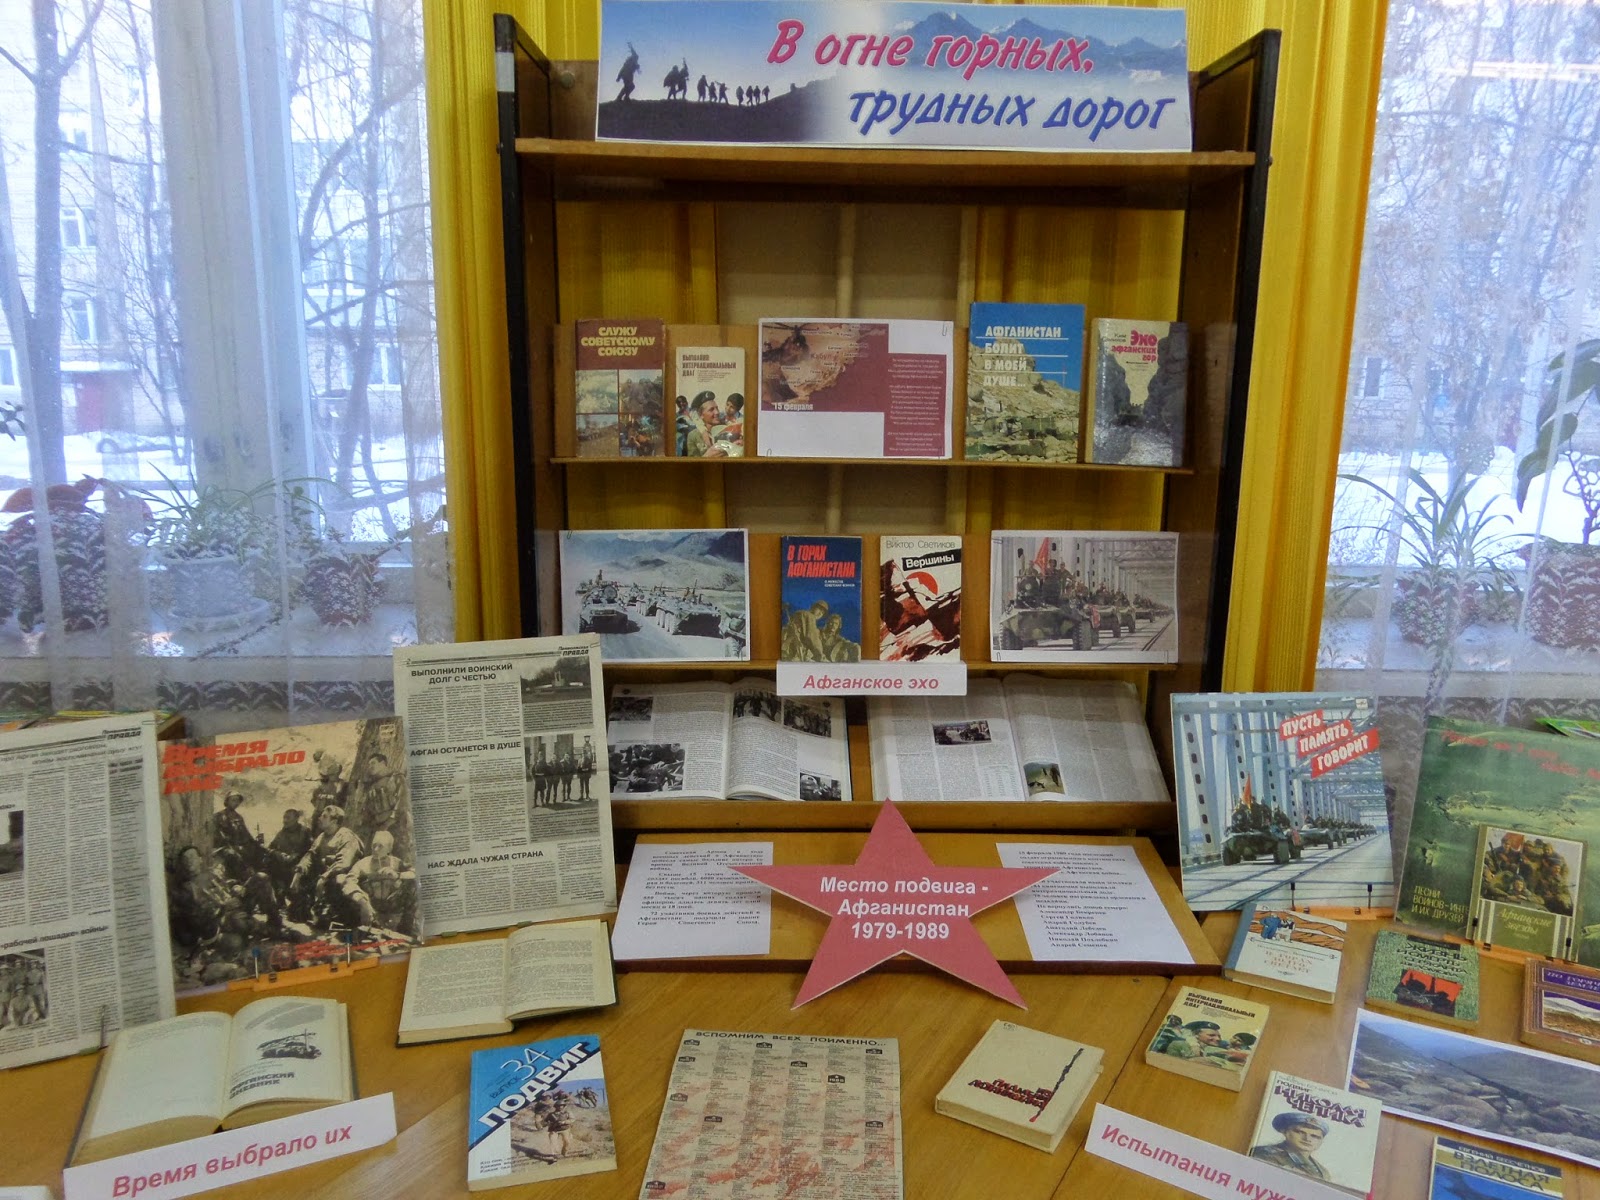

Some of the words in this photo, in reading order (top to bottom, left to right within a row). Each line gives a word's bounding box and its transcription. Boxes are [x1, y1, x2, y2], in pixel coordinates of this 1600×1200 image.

[767, 18, 805, 65] В
[814, 34, 913, 68] огне
[924, 33, 1095, 82] горных,
[847, 87, 1036, 136] трудных
[1042, 95, 1176, 143] дорог
[598, 326, 637, 336] СЛУЖУ
[985, 325, 1062, 338] АФГАНИСТАН
[1130, 329, 1158, 346] Эхо
[581, 336, 655, 347] СОВЕТСКОМУ
[984, 343, 1025, 354] БОЛИТ
[1111, 345, 1157, 354] афганских
[598, 347, 638, 357] СОЮЗУ
[1142, 354, 1157, 363] гор
[984, 360, 993, 370] В
[994, 358, 1027, 371] МОЕЙ
[773, 402, 783, 411] 15
[784, 403, 814, 412] февраля
[885, 539, 915, 549] Виктор
[917, 540, 956, 549] Светиков
[787, 545, 796, 561] В
[797, 545, 827, 561] ГОРАХ
[905, 553, 955, 569] Вершины
[787, 561, 857, 578] АФГАНИСТАНА
[411, 666, 467, 677] ВЫПОЛНИЛИ
[467, 662, 513, 673] ВОИНСКИЙ
[428, 676, 453, 685] ДОЛГ
[455, 675, 461, 683] С
[462, 672, 497, 682] ЧЕСТЬЮ
[803, 674, 903, 690] Афганское
[908, 678, 939, 690] эхо
[1281, 713, 1321, 737] ПУСТЬ
[1299, 723, 1350, 753] ПАМЯТЬ
[410, 747, 439, 757] АФГАН
[440, 743, 490, 754] ОСТАНЕТСЯ
[496, 741, 522, 751] ДУШЕ
[1316, 734, 1369, 771] ГОВОРИТ
[427, 860, 445, 869] НАС
[447, 856, 479, 868] ЖДАЛА
[480, 853, 510, 863] ЧУЖАЯ
[511, 850, 544, 861] СТРАНА
[819, 876, 889, 894] Место
[893, 876, 977, 896] подвига
[1413, 885, 1441, 898] ПЕСНИ
[836, 898, 970, 919] Афганистан
[1411, 904, 1418, 912] И
[1418, 905, 1430, 915] ИХ
[1431, 908, 1464, 923] ДРУЗЕЙ
[850, 921, 951, 940] 1979-1989
[695, 1031, 765, 1040] ВСПОМНИМ
[772, 1034, 802, 1042] ВСЕХ
[809, 1036, 887, 1046] ПОИМЕННО...
[500, 1048, 552, 1081] 34
[478, 1042, 590, 1128] ПОДВИГ
[1276, 1079, 1310, 1092] ПОДВИГ
[1274, 1085, 1367, 1119] НИКОЛАЯ
[1286, 1096, 1365, 1128] ЧЕПИКА
[112, 1163, 198, 1199] Время
[205, 1134, 317, 1173] выбрало
[324, 1123, 353, 1145] их
[1100, 1123, 1233, 1188] Испытания
[1453, 1151, 1550, 1184] ВЗЛЕТНАЯ
[1460, 1160, 1544, 1191] ПОЛОСА
